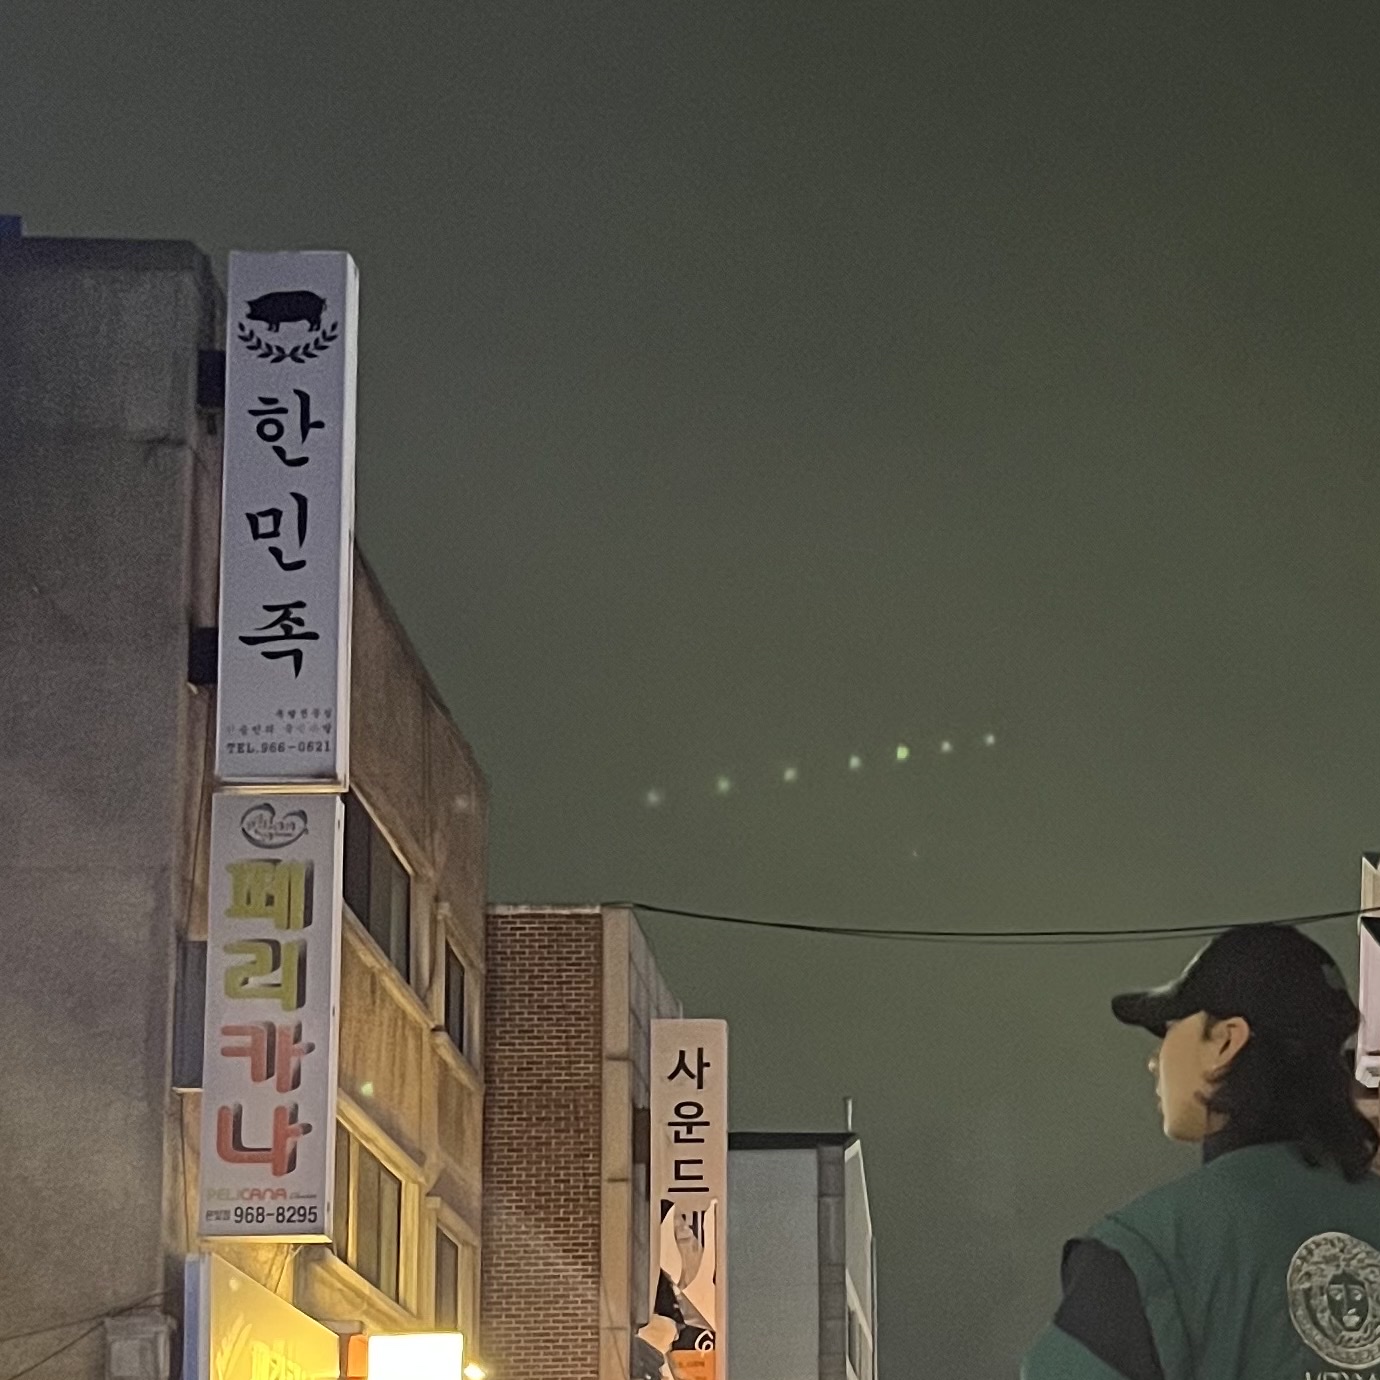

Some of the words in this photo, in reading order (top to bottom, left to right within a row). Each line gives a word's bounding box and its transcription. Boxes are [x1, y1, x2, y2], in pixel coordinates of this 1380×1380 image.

[238, 388, 325, 680] 한민족
[215, 858, 316, 1177] 페리카나
[234, 1205, 318, 1223] 968-8295
